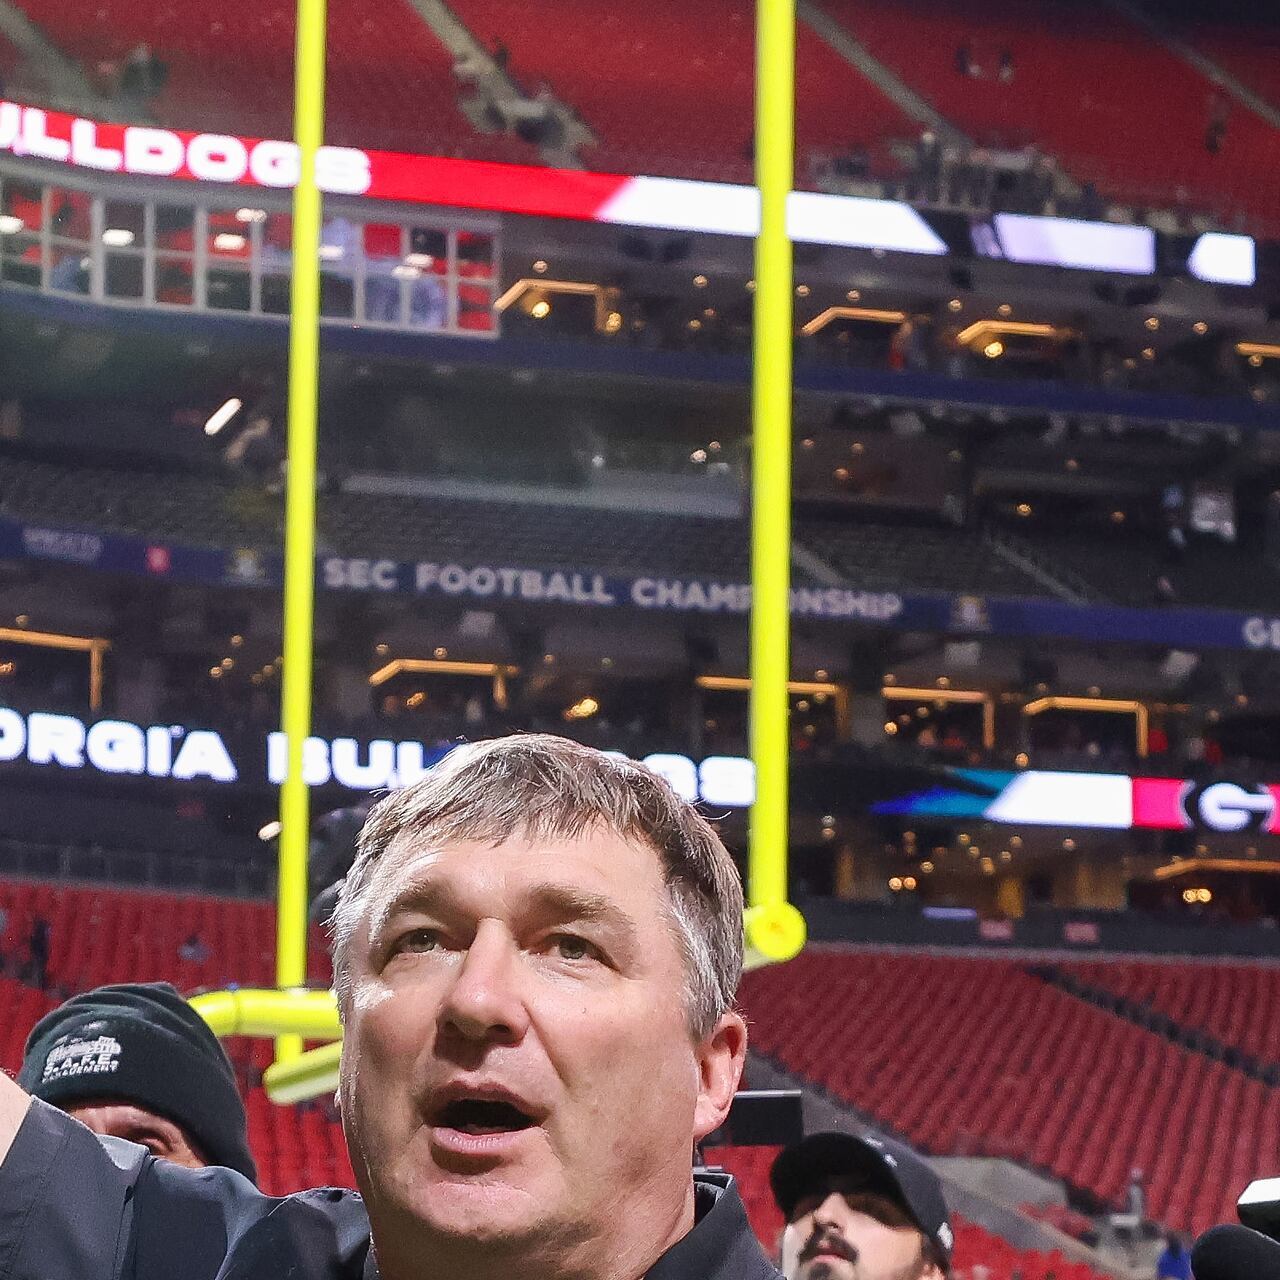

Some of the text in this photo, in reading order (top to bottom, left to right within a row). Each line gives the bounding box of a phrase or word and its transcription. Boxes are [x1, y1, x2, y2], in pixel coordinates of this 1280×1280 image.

[324, 558, 903, 619] SEC FOOTBALL CHAMPNSHIP
